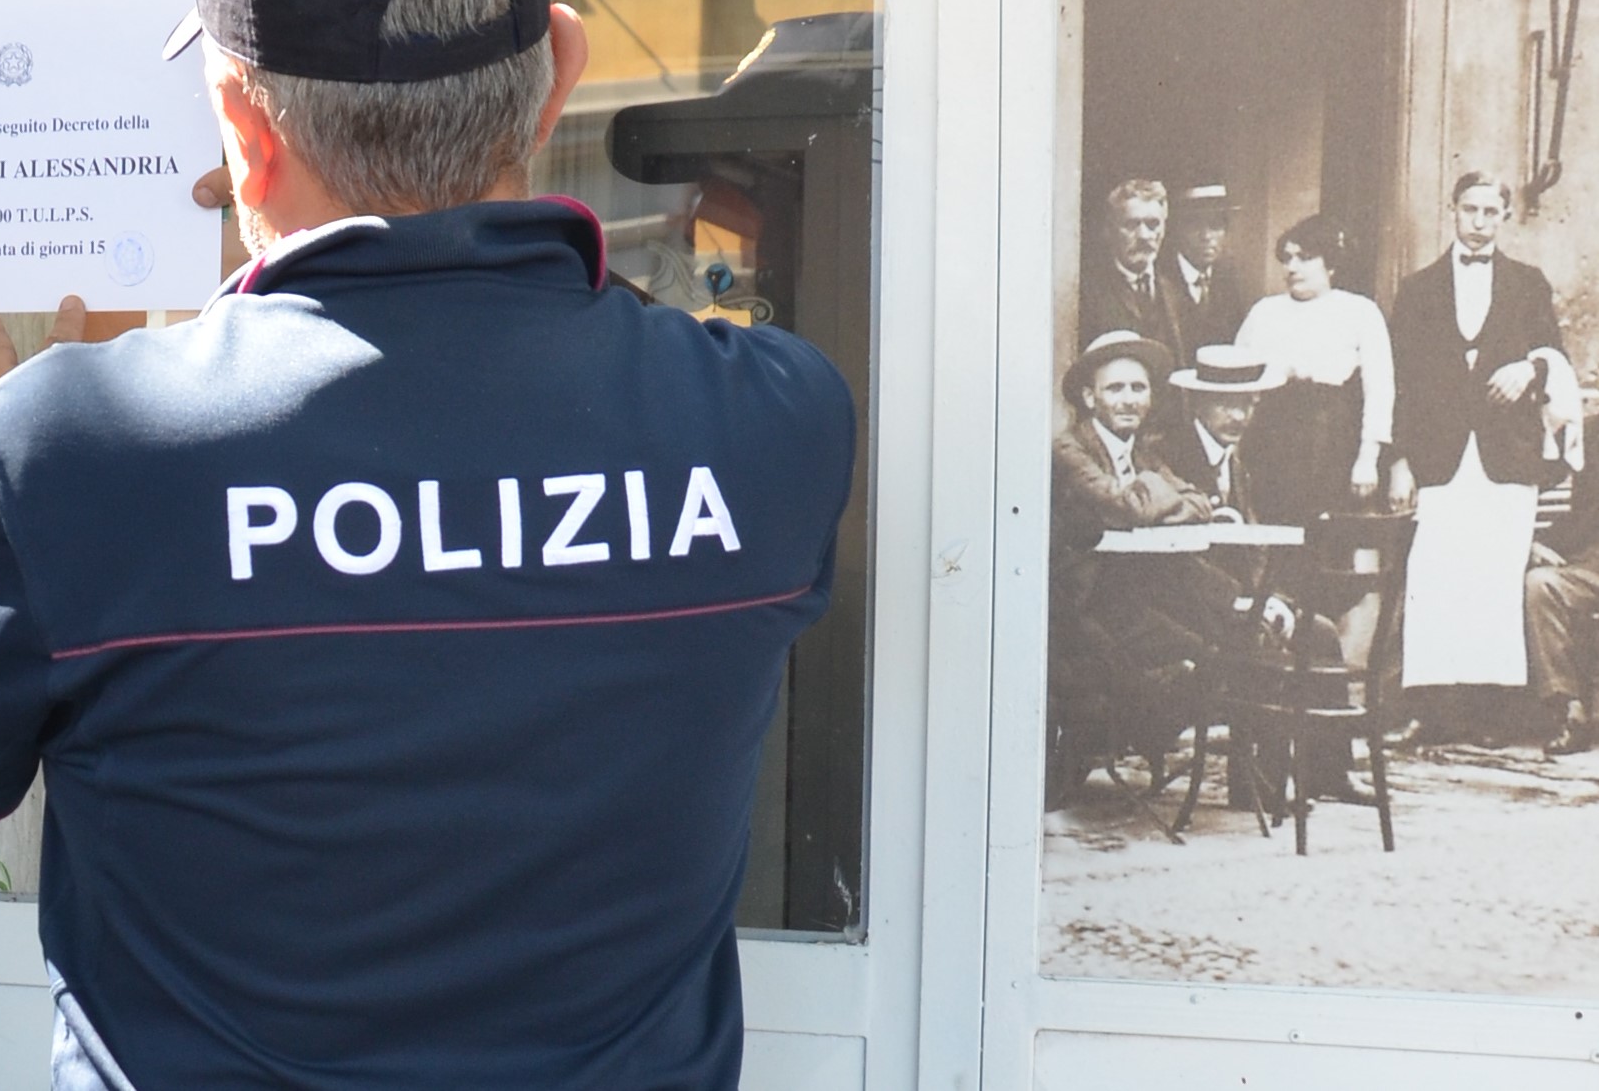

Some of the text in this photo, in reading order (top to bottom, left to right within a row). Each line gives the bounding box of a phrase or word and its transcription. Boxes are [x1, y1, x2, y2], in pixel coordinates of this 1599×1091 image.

[51, 116, 110, 132] Decreto
[113, 114, 150, 131] della
[13, 155, 180, 179] ALESSANDRIA
[16, 206, 94, 223] T.U.L.P.S.
[20, 240, 35, 256] di
[39, 240, 83, 259] giorni
[89, 239, 106, 254] 15
[226, 466, 742, 580] POLIZIA
